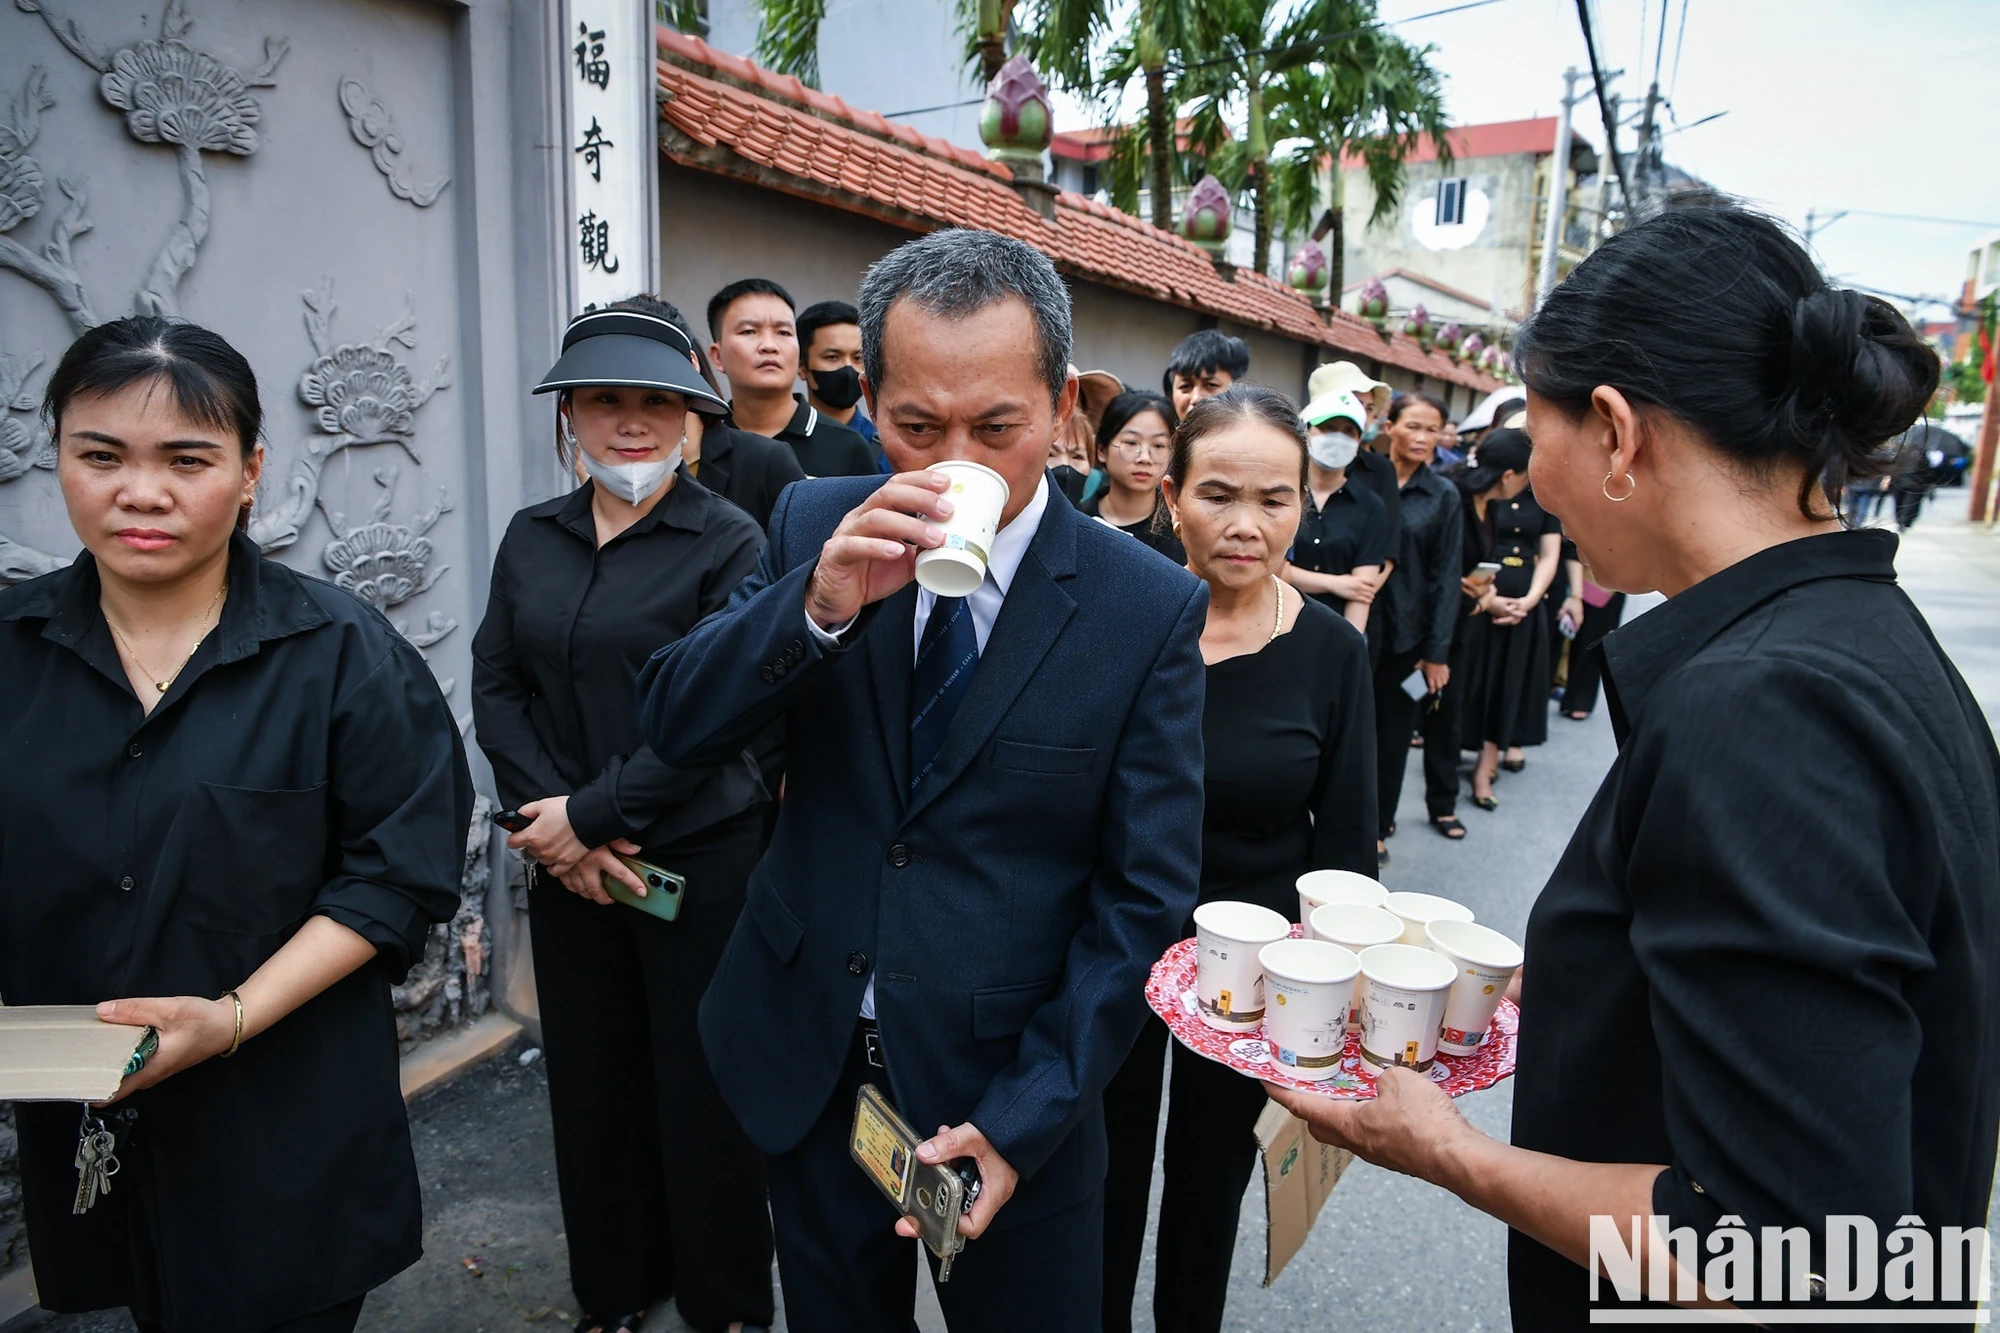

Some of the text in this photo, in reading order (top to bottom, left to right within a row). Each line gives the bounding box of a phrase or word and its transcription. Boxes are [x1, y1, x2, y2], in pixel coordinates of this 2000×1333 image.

[573, 21, 619, 313] 福奇觀
[943, 668, 960, 688] VIETNAM
